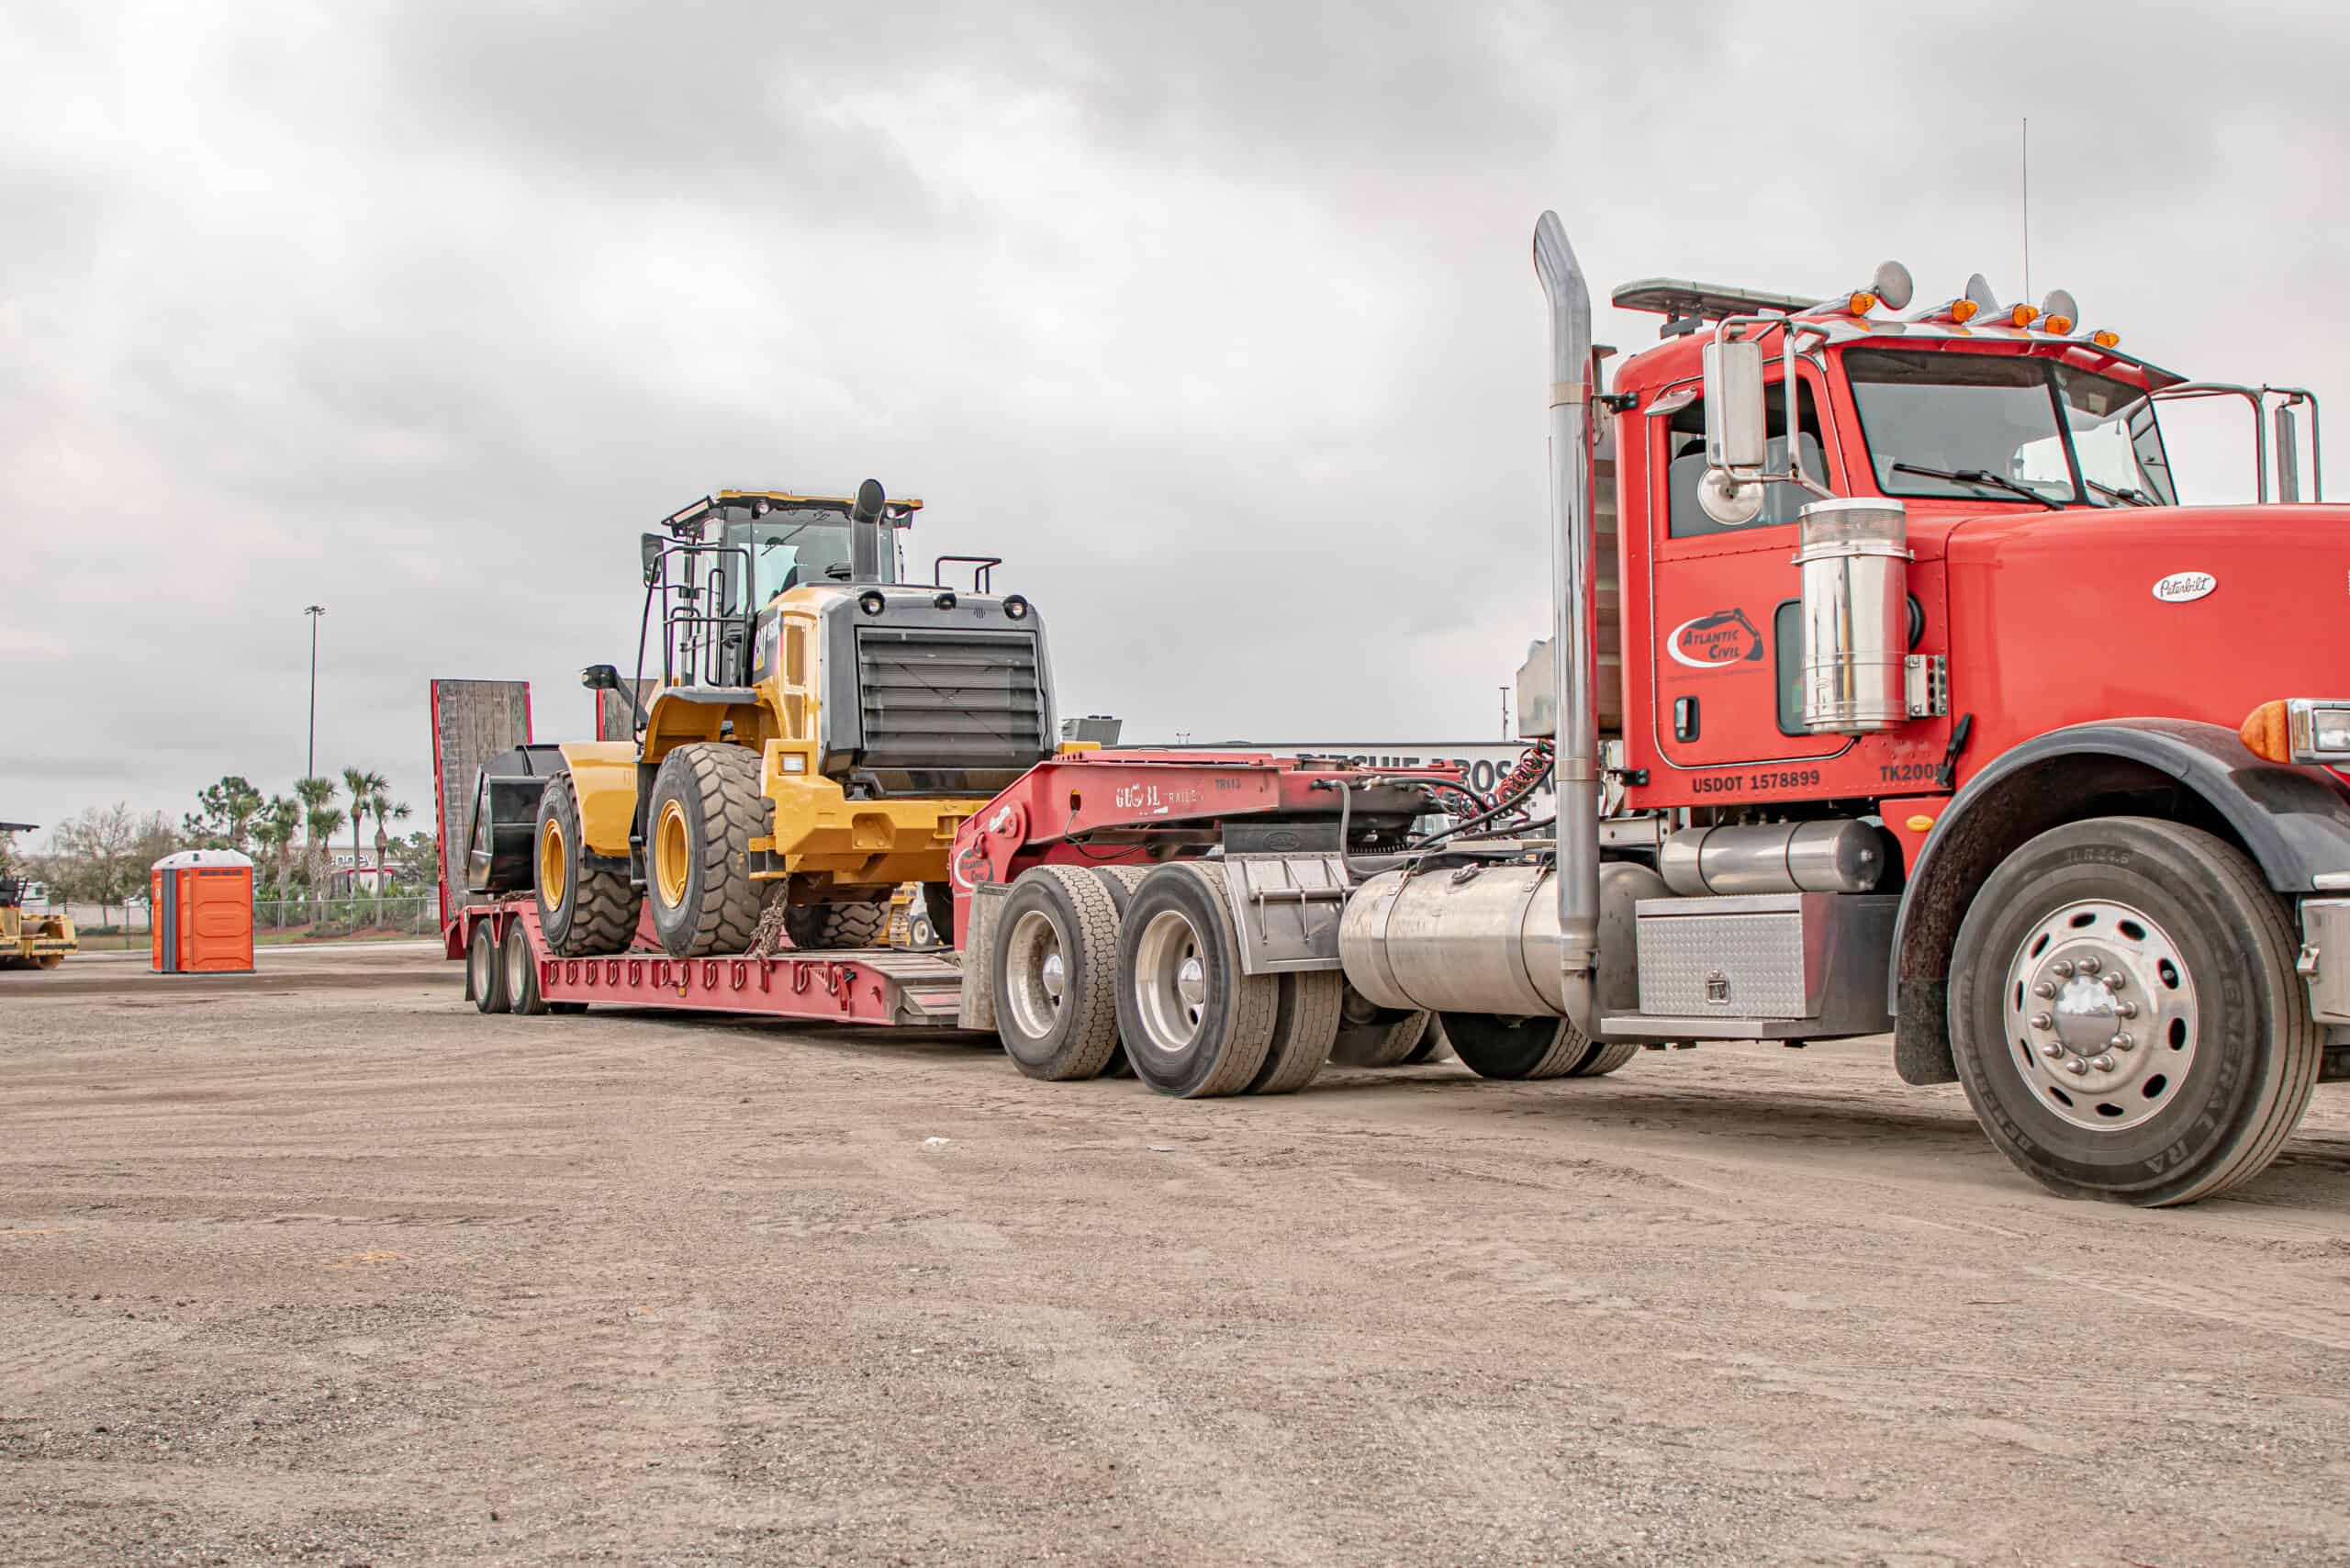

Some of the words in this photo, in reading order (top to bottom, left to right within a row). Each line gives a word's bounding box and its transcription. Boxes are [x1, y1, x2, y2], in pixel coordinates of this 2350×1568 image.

[2160, 577, 2211, 598] Peterbilt
[1682, 630, 1740, 646] ATLANTIC
[1708, 644, 1740, 659] CIVIL
[1692, 776, 1743, 793] USDOT
[1751, 769, 1820, 790] 1578899
